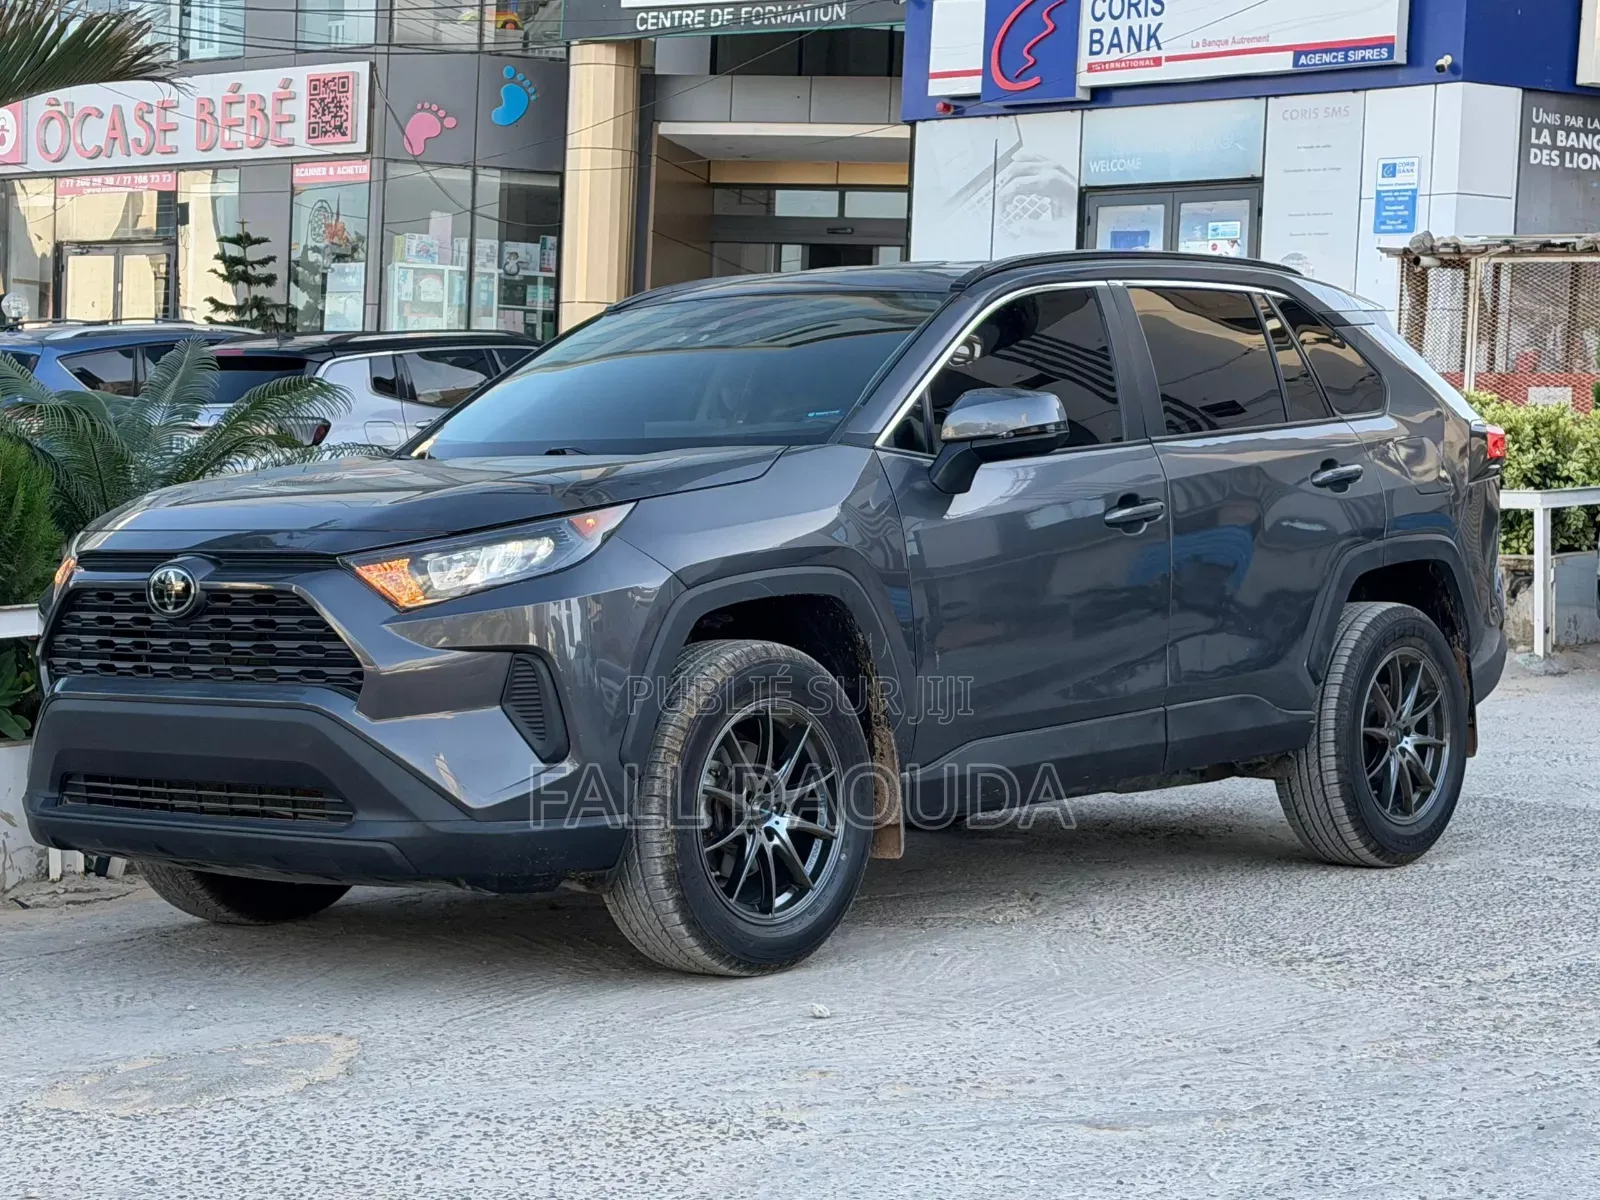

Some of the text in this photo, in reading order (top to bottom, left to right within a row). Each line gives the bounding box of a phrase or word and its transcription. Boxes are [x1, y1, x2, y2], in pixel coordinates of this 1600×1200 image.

[636, 3, 846, 31] CENTRE DE FORMATION
[1091, 0, 1165, 22] CORIS
[1088, 22, 1164, 57] BANK
[1191, 34, 1270, 49] La Banque Autrement
[1091, 59, 1155, 71] INTERNATIONAL
[1298, 48, 1389, 66] AGENCE SIPRES
[195, 77, 296, 152] BÉBÉ
[1282, 106, 1350, 121] CORIS SMS
[1530, 127, 1552, 146] LA
[1089, 157, 1142, 173] WELCOME
[1529, 148, 1600, 170] DES LION
[295, 165, 368, 177] SCANNER & ACHETER
